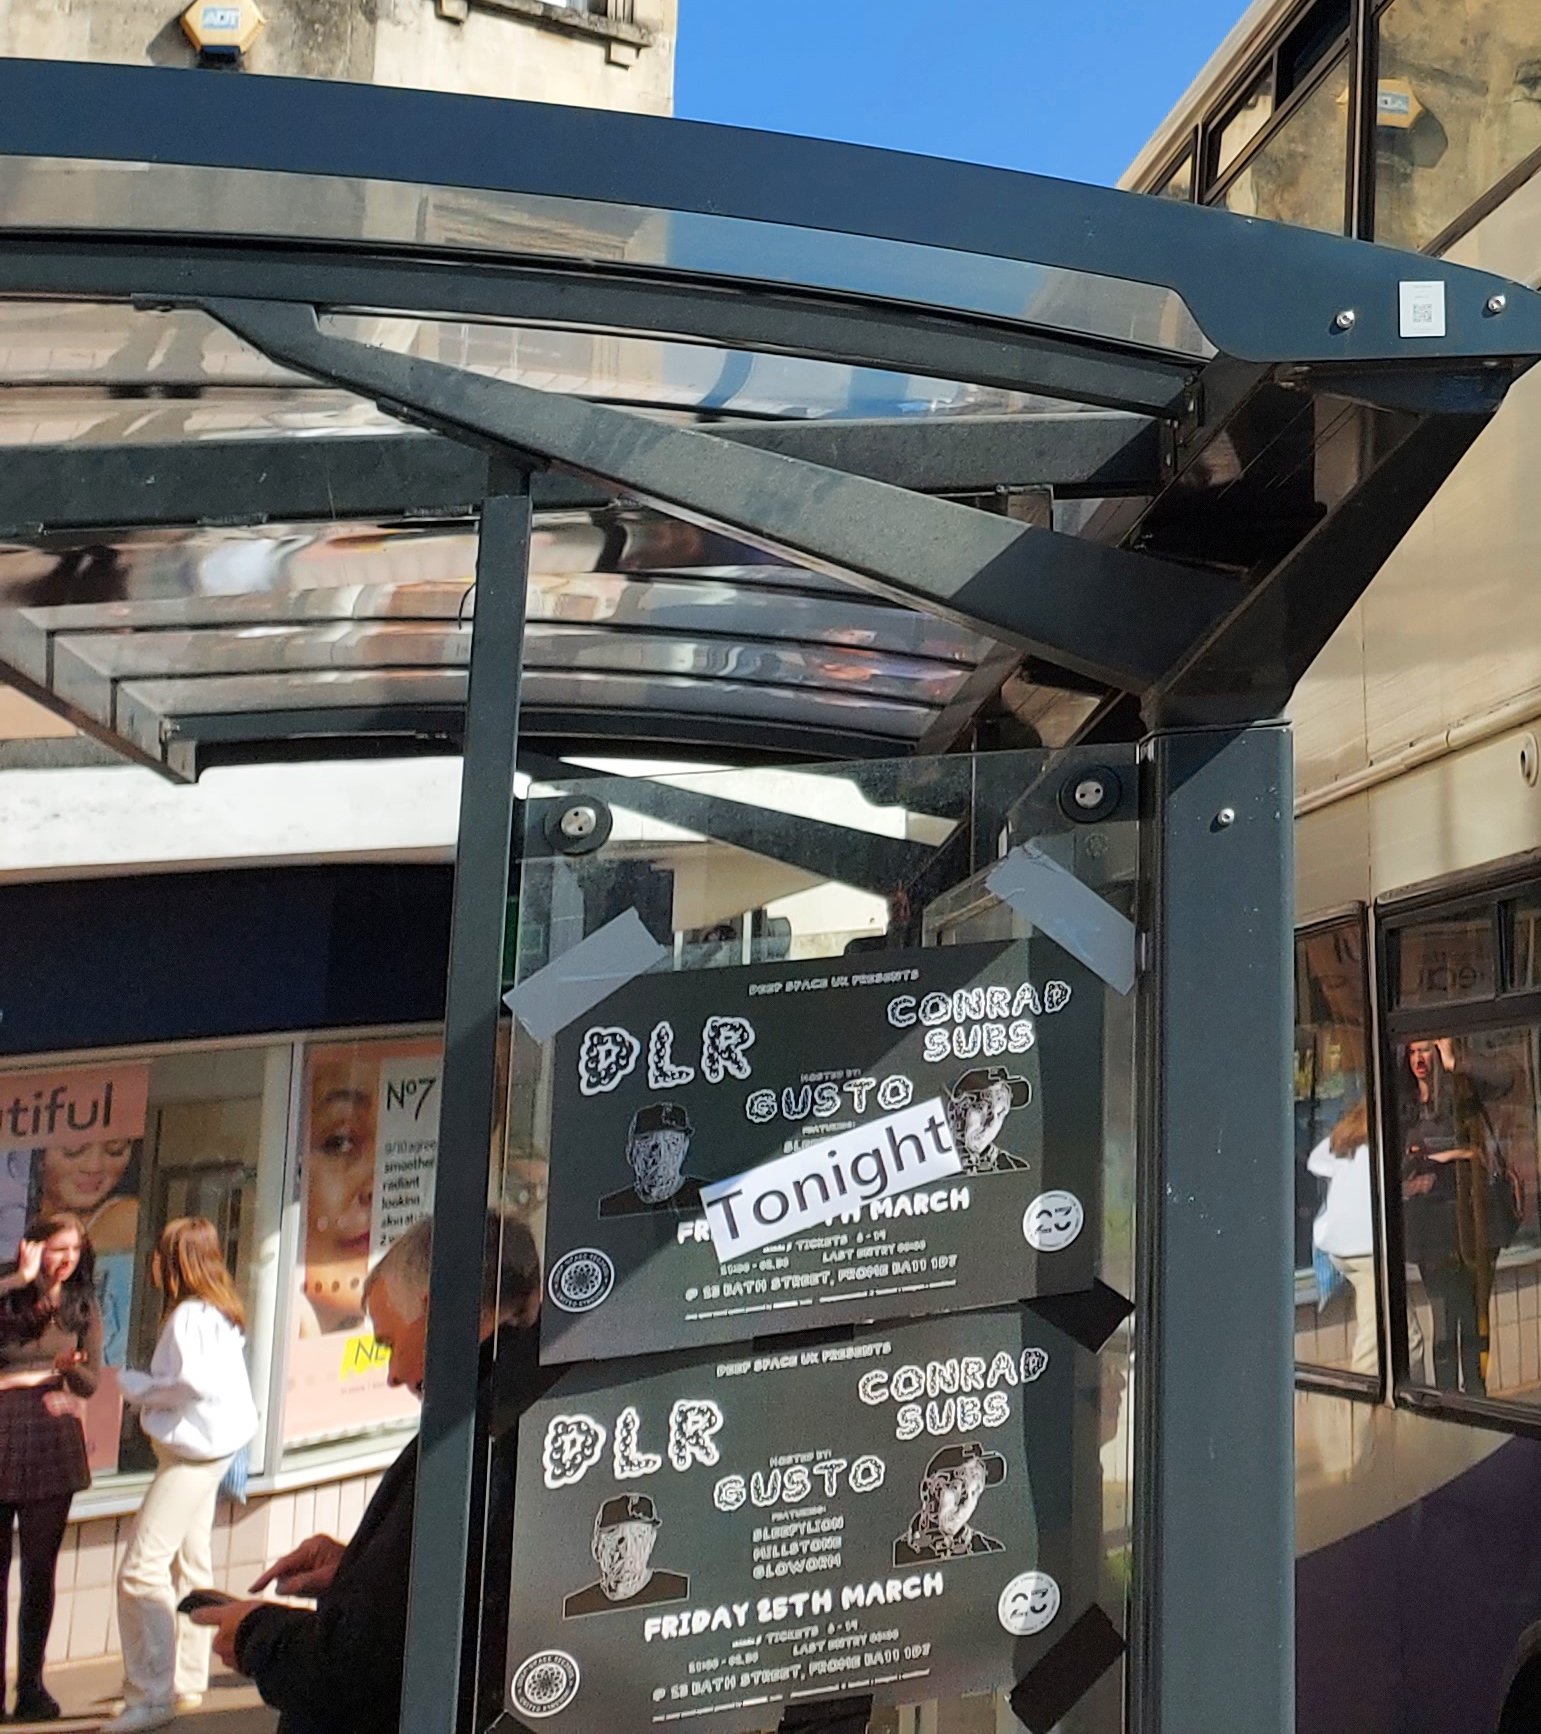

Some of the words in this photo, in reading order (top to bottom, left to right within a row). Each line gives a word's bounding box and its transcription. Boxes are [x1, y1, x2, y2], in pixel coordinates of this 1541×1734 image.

[887, 980, 1072, 1027] CONRAD
[579, 1016, 755, 1096] DLR
[923, 1020, 1036, 1062] SUBS
[0, 1081, 113, 1137] tiful
[745, 1075, 913, 1122] GUSTO
[706, 1113, 955, 1242] Tonight
[869, 1187, 970, 1221] MARCH
[724, 1279, 767, 1298] BATH
[771, 1270, 835, 1291] STREET,
[822, 1342, 892, 1363] PRESENTS
[858, 1347, 1048, 1405] CONRAD
[896, 1392, 1009, 1440] SUBS
[543, 1400, 723, 1488] DLR
[714, 1454, 884, 1512] GUSTO
[644, 1599, 750, 1643] FRIDAY
[758, 1589, 833, 1623] 25TH
[841, 1571, 945, 1610] MARCH
[691, 1674, 737, 1696] BATH
[740, 1663, 806, 1687] STREET,
